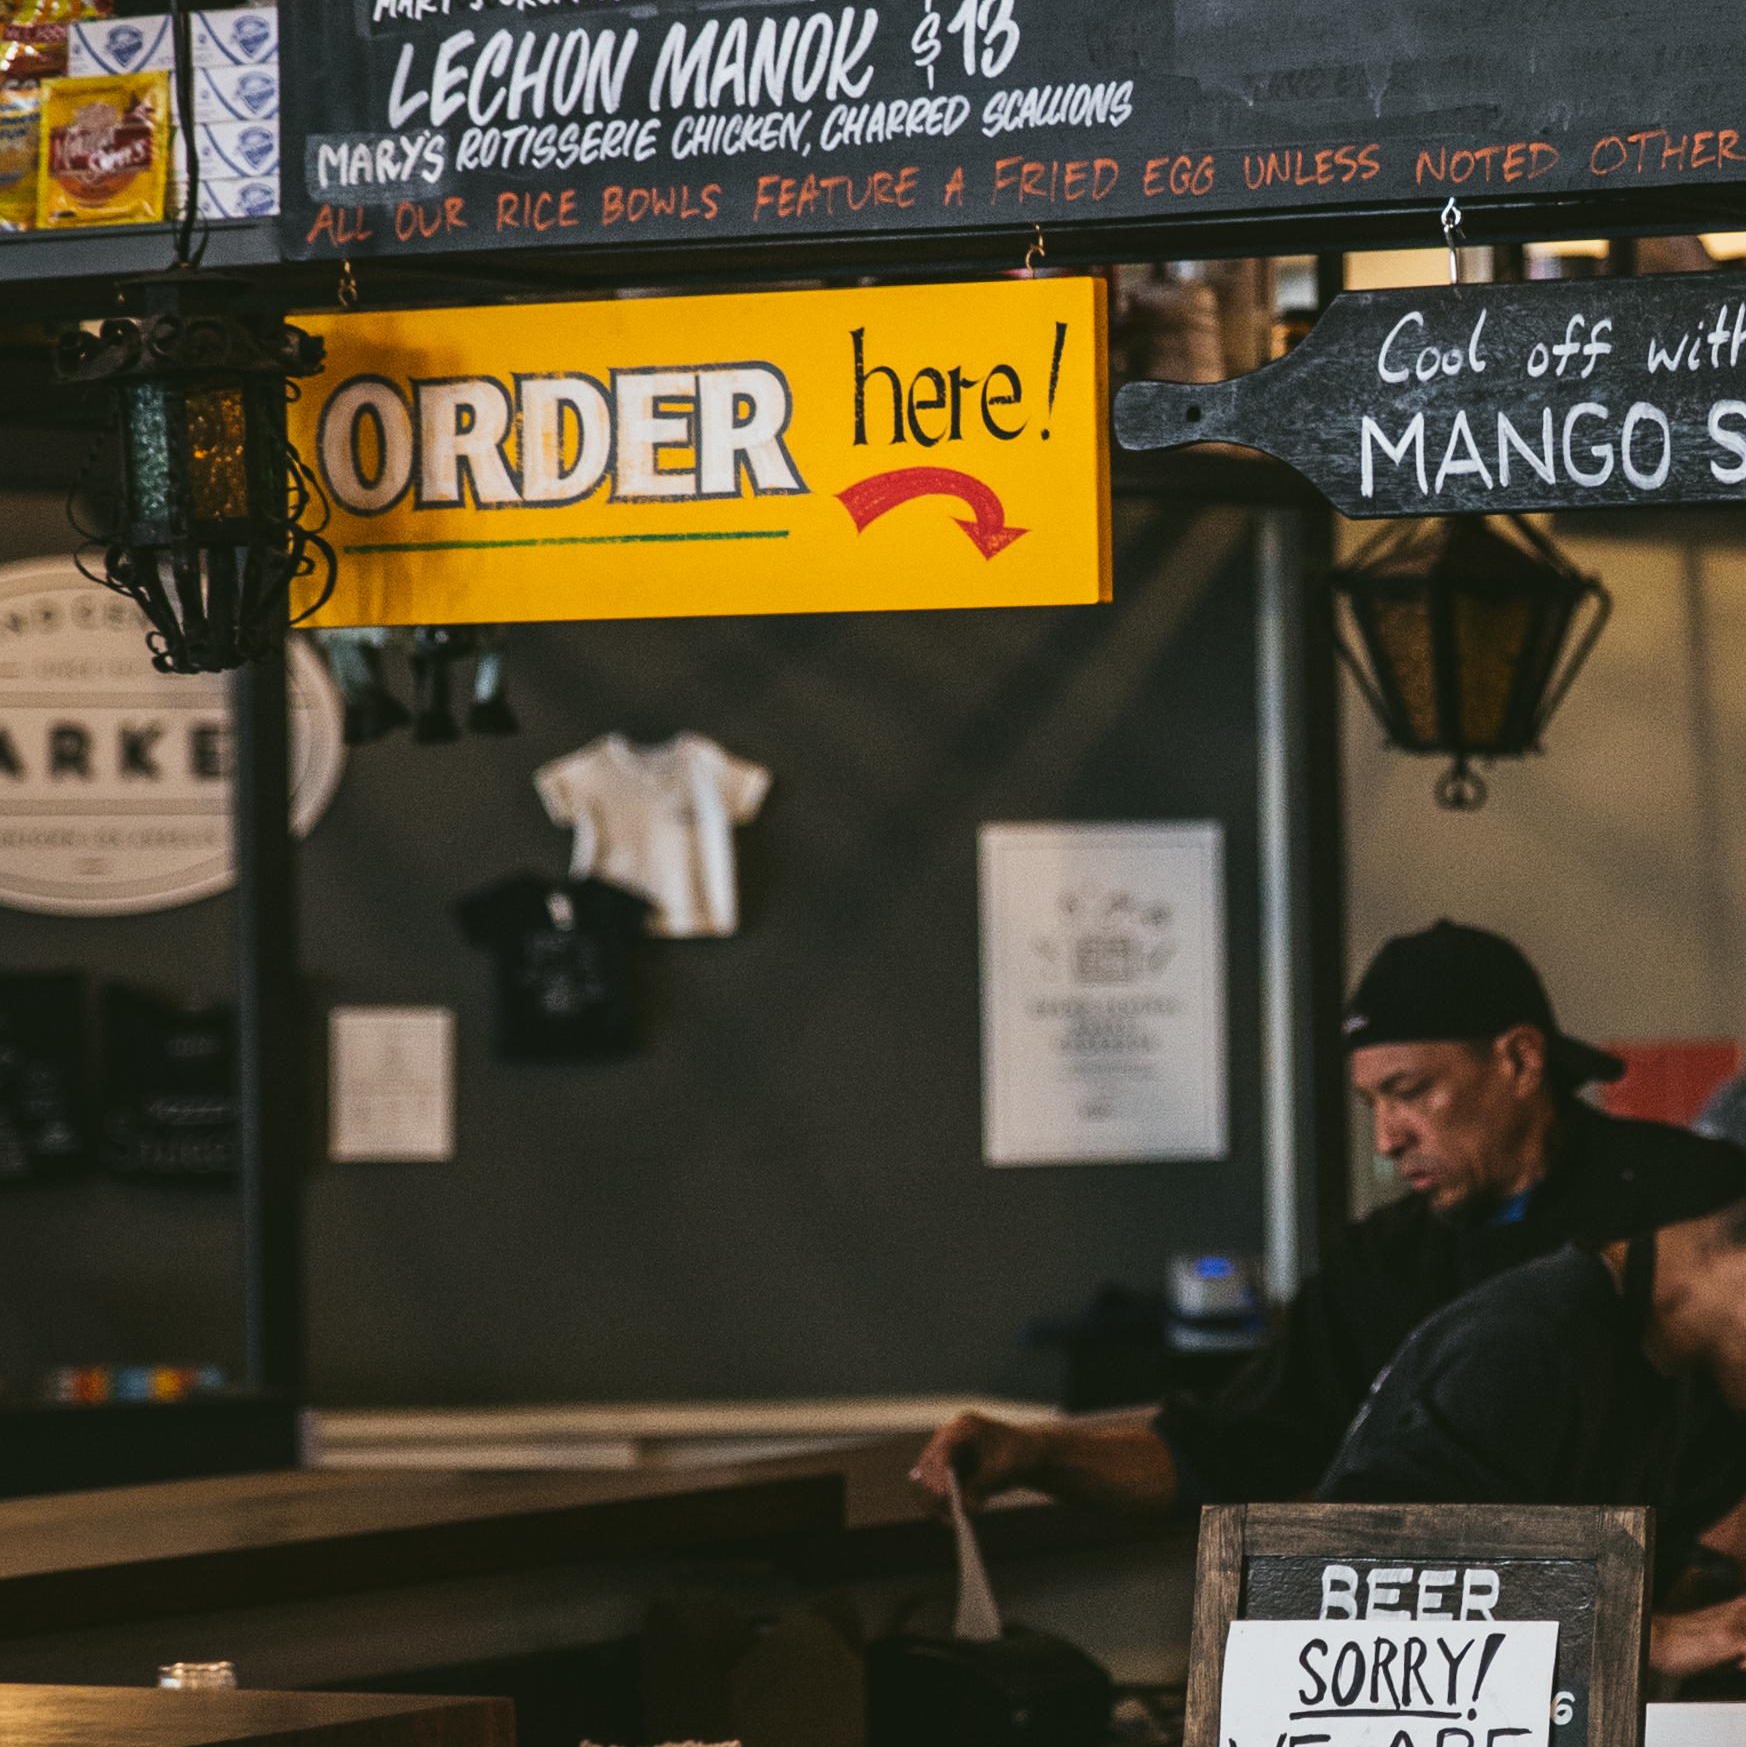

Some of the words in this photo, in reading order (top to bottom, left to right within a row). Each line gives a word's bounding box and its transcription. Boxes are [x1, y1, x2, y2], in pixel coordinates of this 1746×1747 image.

[389, 24, 640, 130] LECHON
[649, 7, 878, 113] MANOK
[317, 131, 446, 189] MARY'S
[456, 116, 658, 173] ROTISSERIE
[671, 109, 811, 160] CHICKEN,
[819, 94, 970, 151] CHARRED
[982, 80, 1134, 137] SCALLIONS
[306, 201, 374, 247] ALL
[392, 193, 469, 240] OUR
[494, 186, 580, 229] RICE
[600, 178, 720, 225] BOWLS
[752, 166, 931, 224] FEATURE
[992, 152, 1126, 206] FRIED
[1140, 156, 1216, 198] EGG
[1242, 142, 1381, 188] UNLESS
[1415, 135, 1559, 185] NOTED
[1378, 308, 1487, 384] Cool
[1526, 313, 1613, 380] off
[317, 361, 807, 515] ORDER
[848, 321, 1067, 450] here!
[1360, 401, 1672, 499] MANGO
[1319, 1565, 1500, 1621] BEER
[1298, 1632, 1506, 1722] SORRY!
